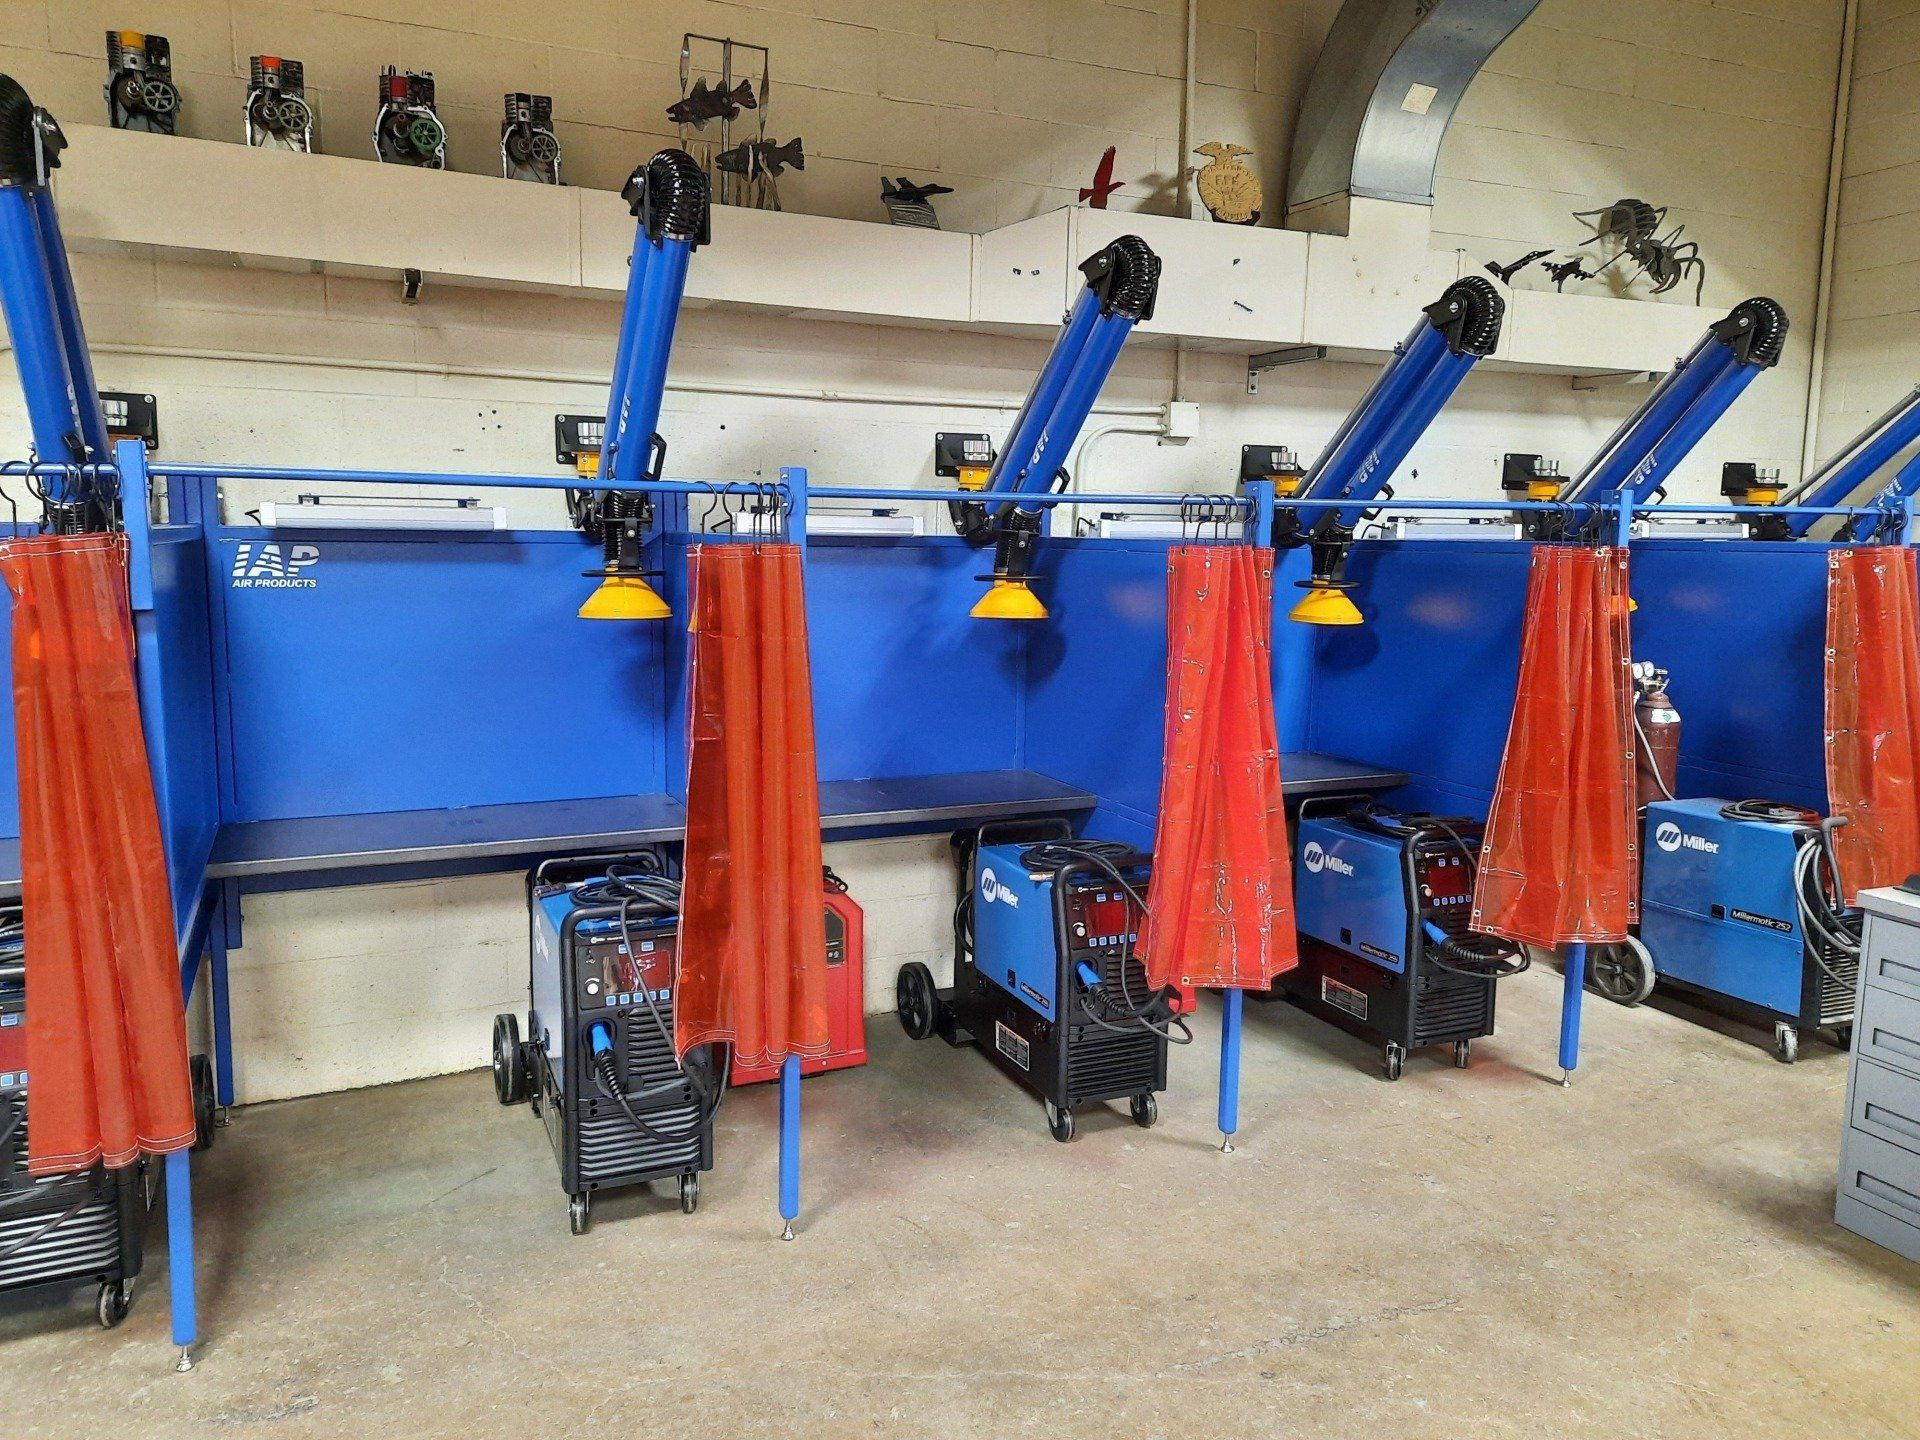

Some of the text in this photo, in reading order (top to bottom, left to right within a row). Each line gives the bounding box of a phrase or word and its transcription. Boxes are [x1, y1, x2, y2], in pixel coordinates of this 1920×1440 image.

[231, 544, 320, 577] IAP
[232, 579, 317, 588] AIR PRODUCTS
[1683, 834, 1720, 854] Miller
[1325, 853, 1354, 876] Miller
[996, 882, 1019, 908] Miller
[1775, 921, 1791, 932] 252
